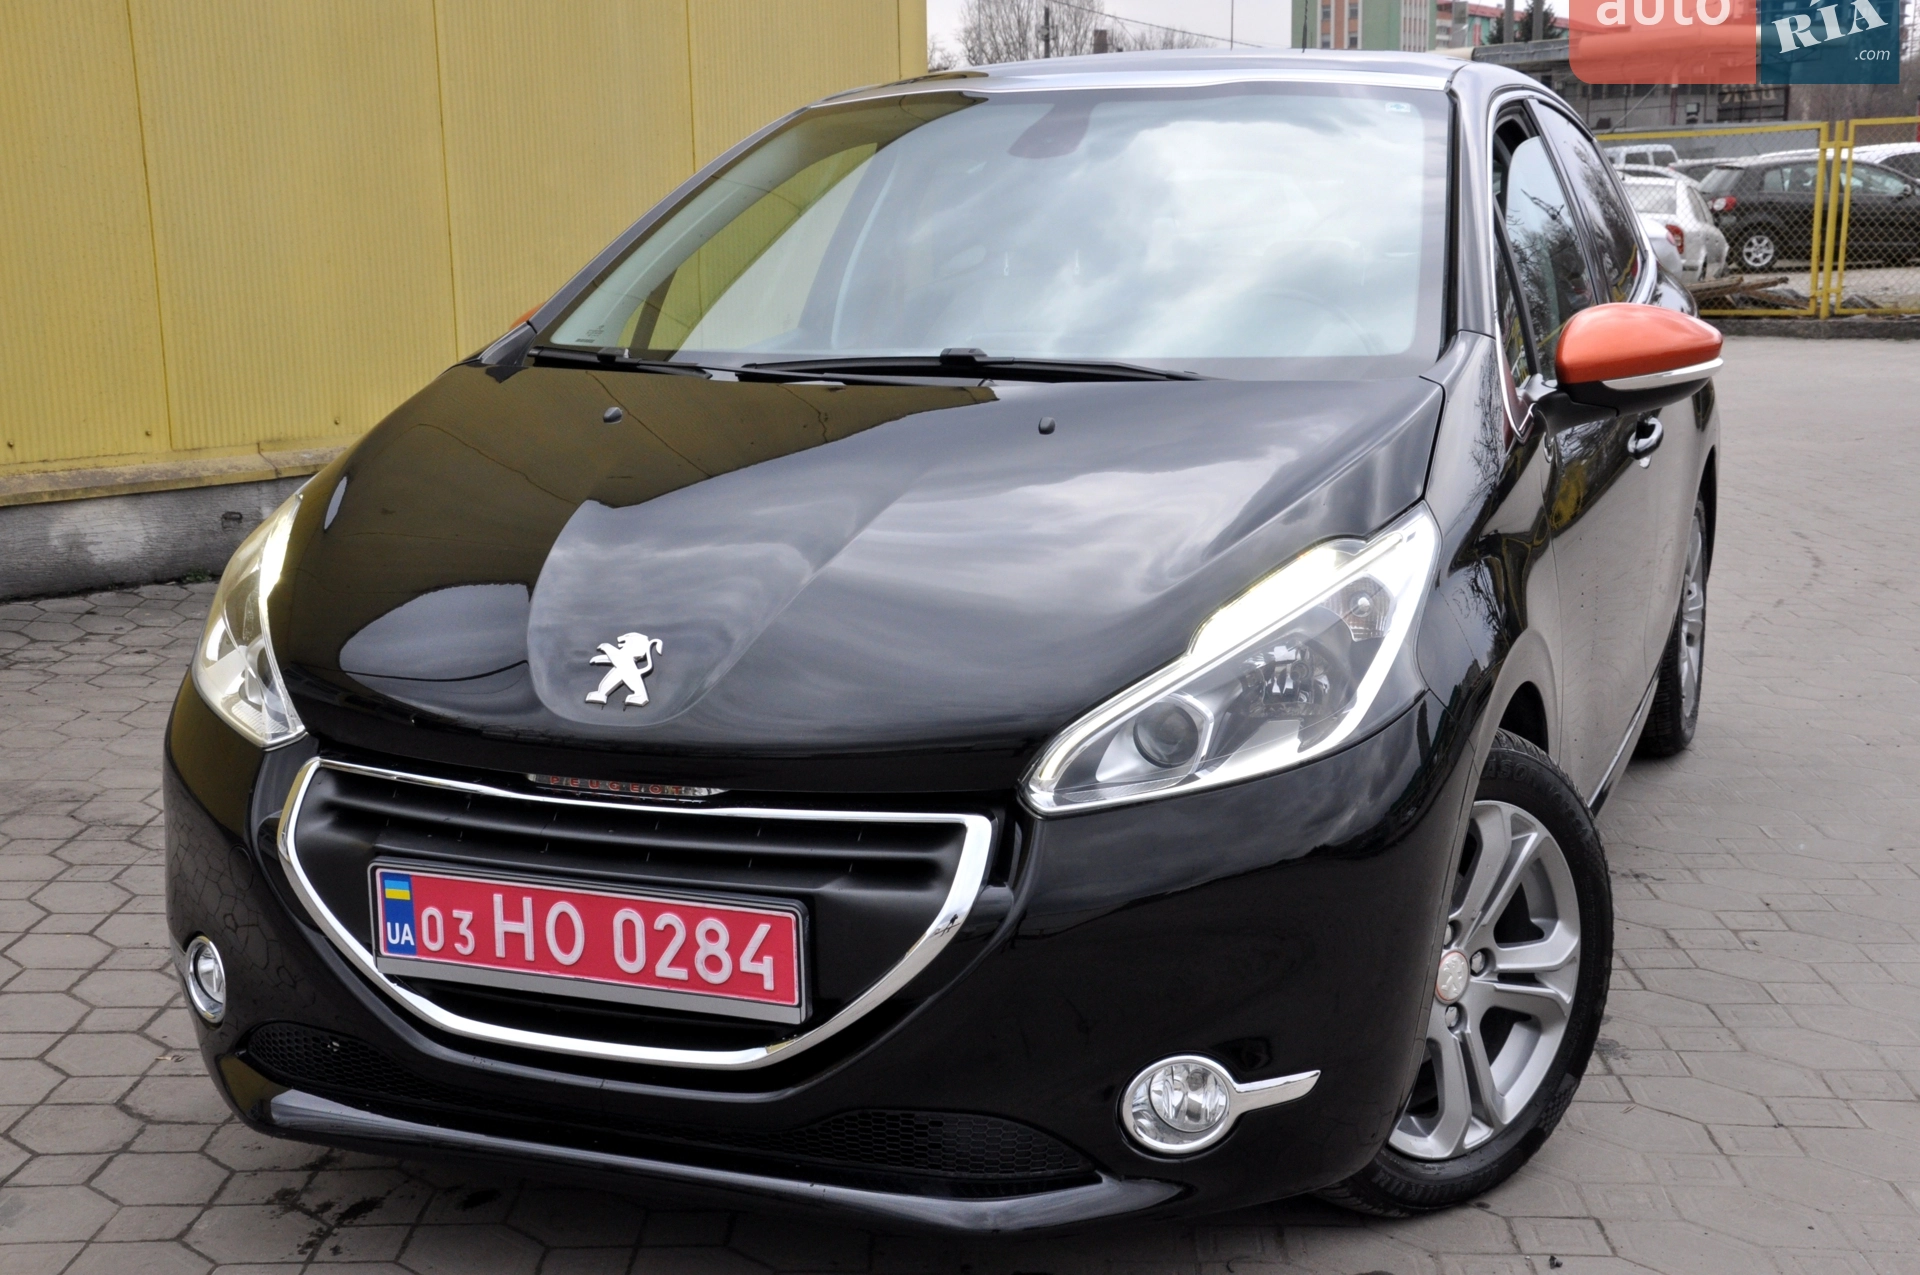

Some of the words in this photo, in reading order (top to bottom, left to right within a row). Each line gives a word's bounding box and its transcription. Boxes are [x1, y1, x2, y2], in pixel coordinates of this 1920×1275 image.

[551, 775, 683, 795] PEUGEOT
[386, 921, 415, 946] UA
[420, 906, 476, 956] 03
[492, 893, 586, 966] HO
[612, 908, 775, 991] 0284
